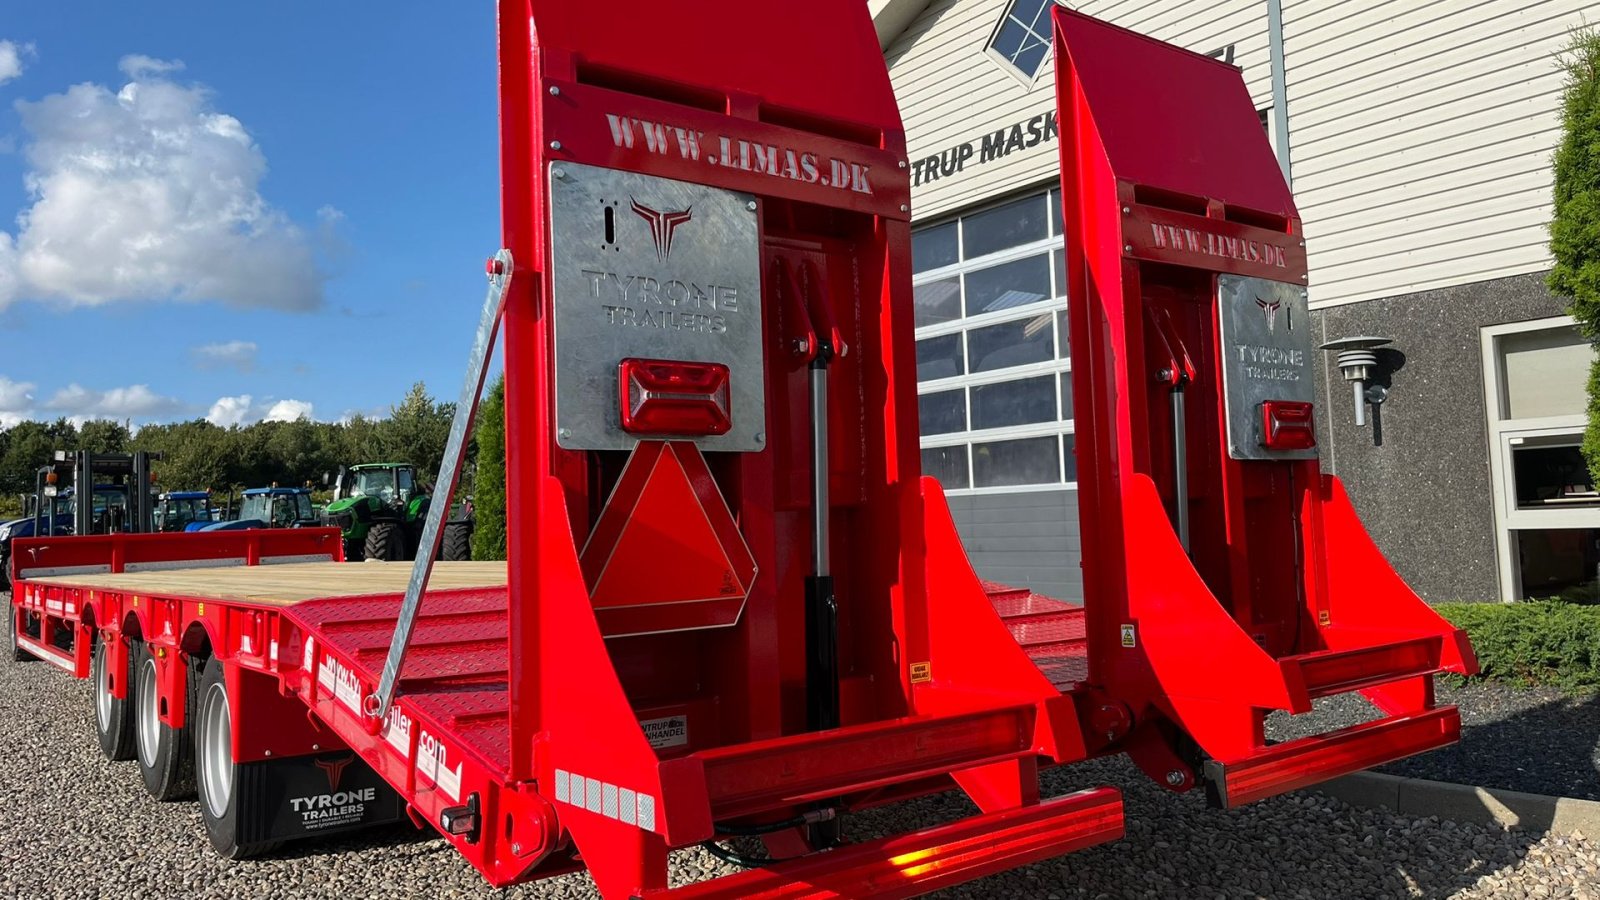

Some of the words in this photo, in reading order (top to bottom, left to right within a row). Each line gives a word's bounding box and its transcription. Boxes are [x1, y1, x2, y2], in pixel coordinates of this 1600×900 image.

[605, 113, 873, 194] WWW.LIMAS.DK
[1151, 223, 1287, 268] WWW.LIMAS.DK
[581, 269, 738, 312] TYRONE
[602, 304, 727, 334] TRAILERS
[1235, 343, 1304, 367] TYRONE
[1247, 366, 1300, 381] TRAILERS
[290, 787, 376, 812] TYRONE
[302, 803, 365, 820] TRAILERS
